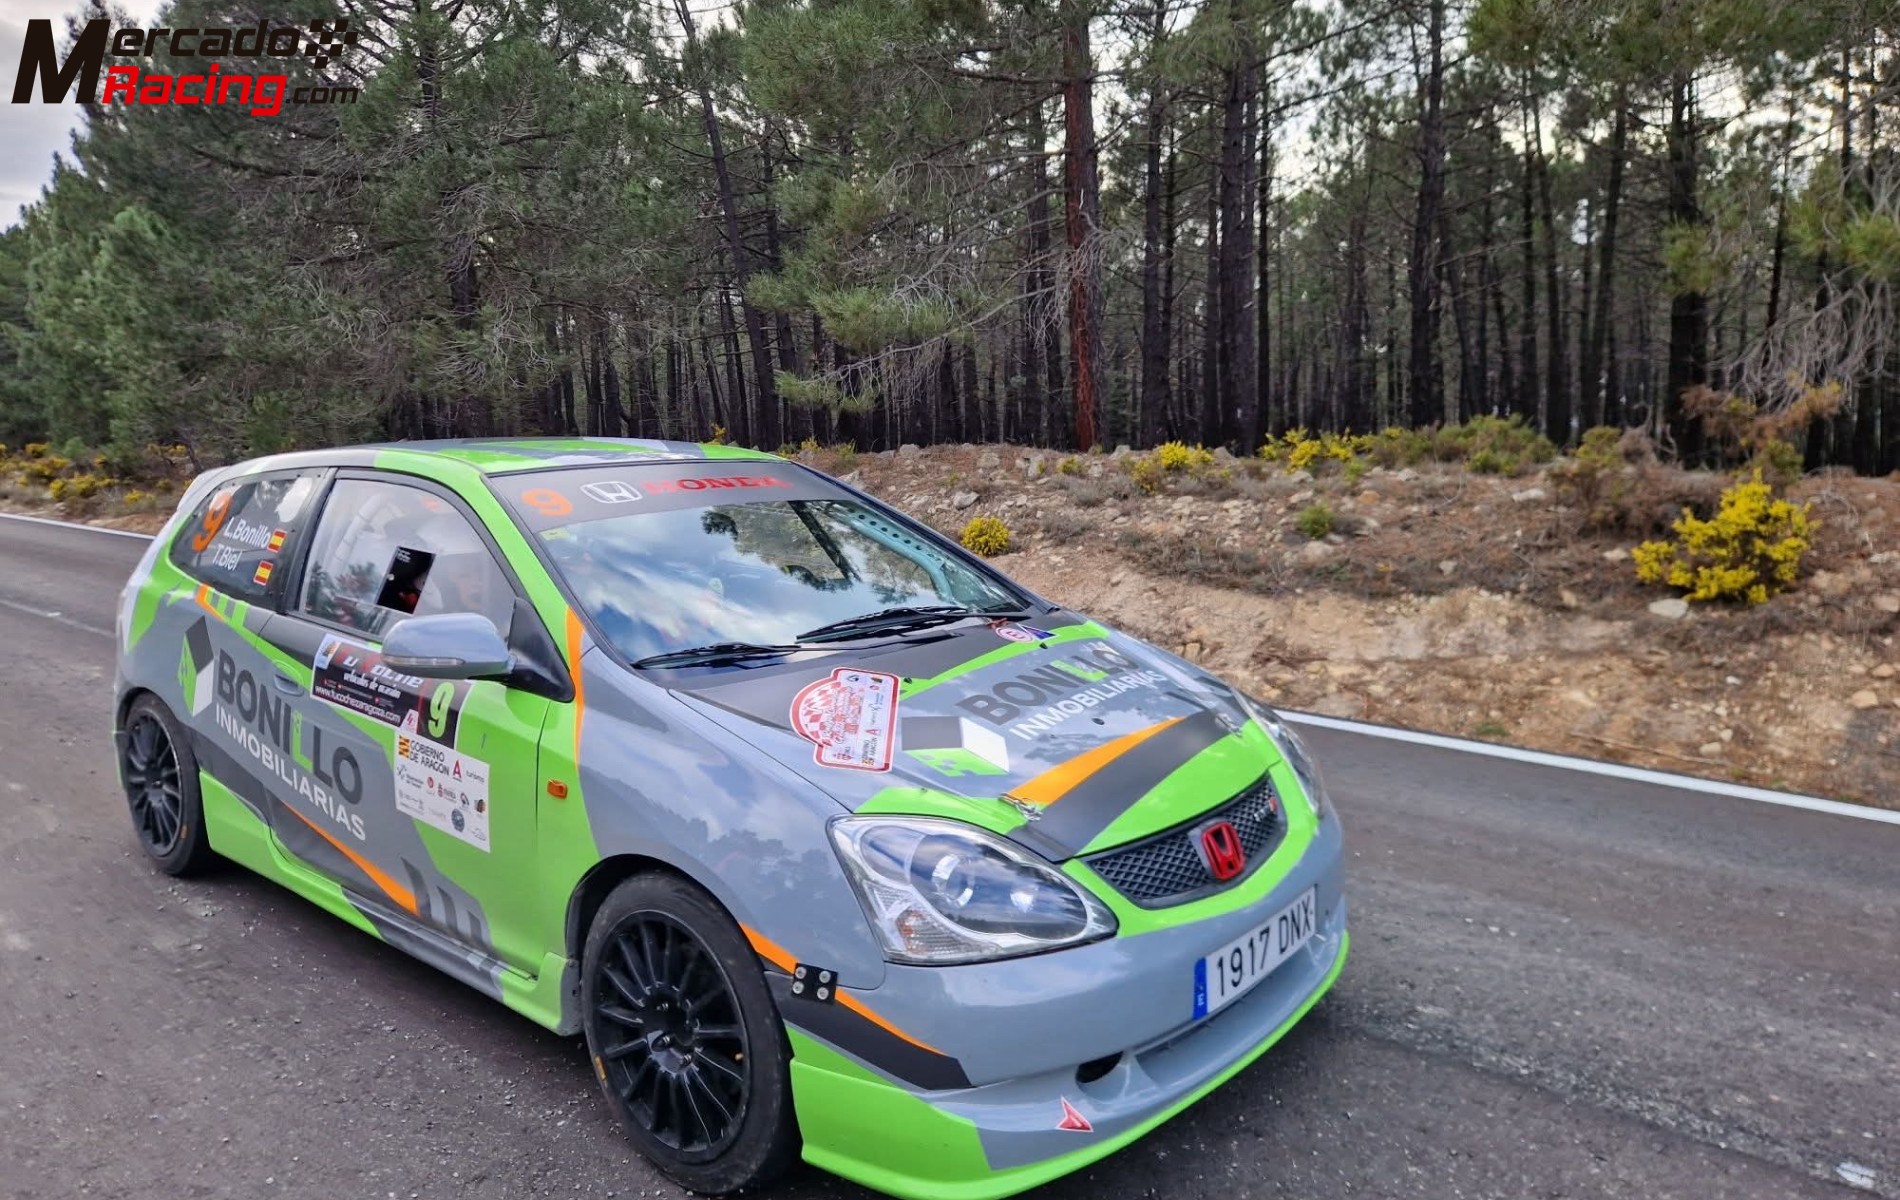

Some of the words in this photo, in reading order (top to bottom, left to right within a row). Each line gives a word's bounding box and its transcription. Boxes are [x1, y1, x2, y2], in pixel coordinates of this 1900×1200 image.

[520, 487, 573, 517] 9
[643, 475, 793, 496] HONDA
[193, 491, 233, 554] 9
[223, 516, 271, 549] L.Bonillo
[212, 544, 243, 571] T.Biel
[428, 682, 454, 738] 9
[955, 646, 1140, 726] BONILLO
[1008, 669, 1168, 741] INMOBILIARIAS
[217, 648, 363, 805] BONILLO
[410, 740, 445, 763] GOBIERNO
[215, 703, 366, 841] INMOBILIARIAS
[1216, 926, 1271, 997] 1917
[1279, 895, 1311, 954] DNX
